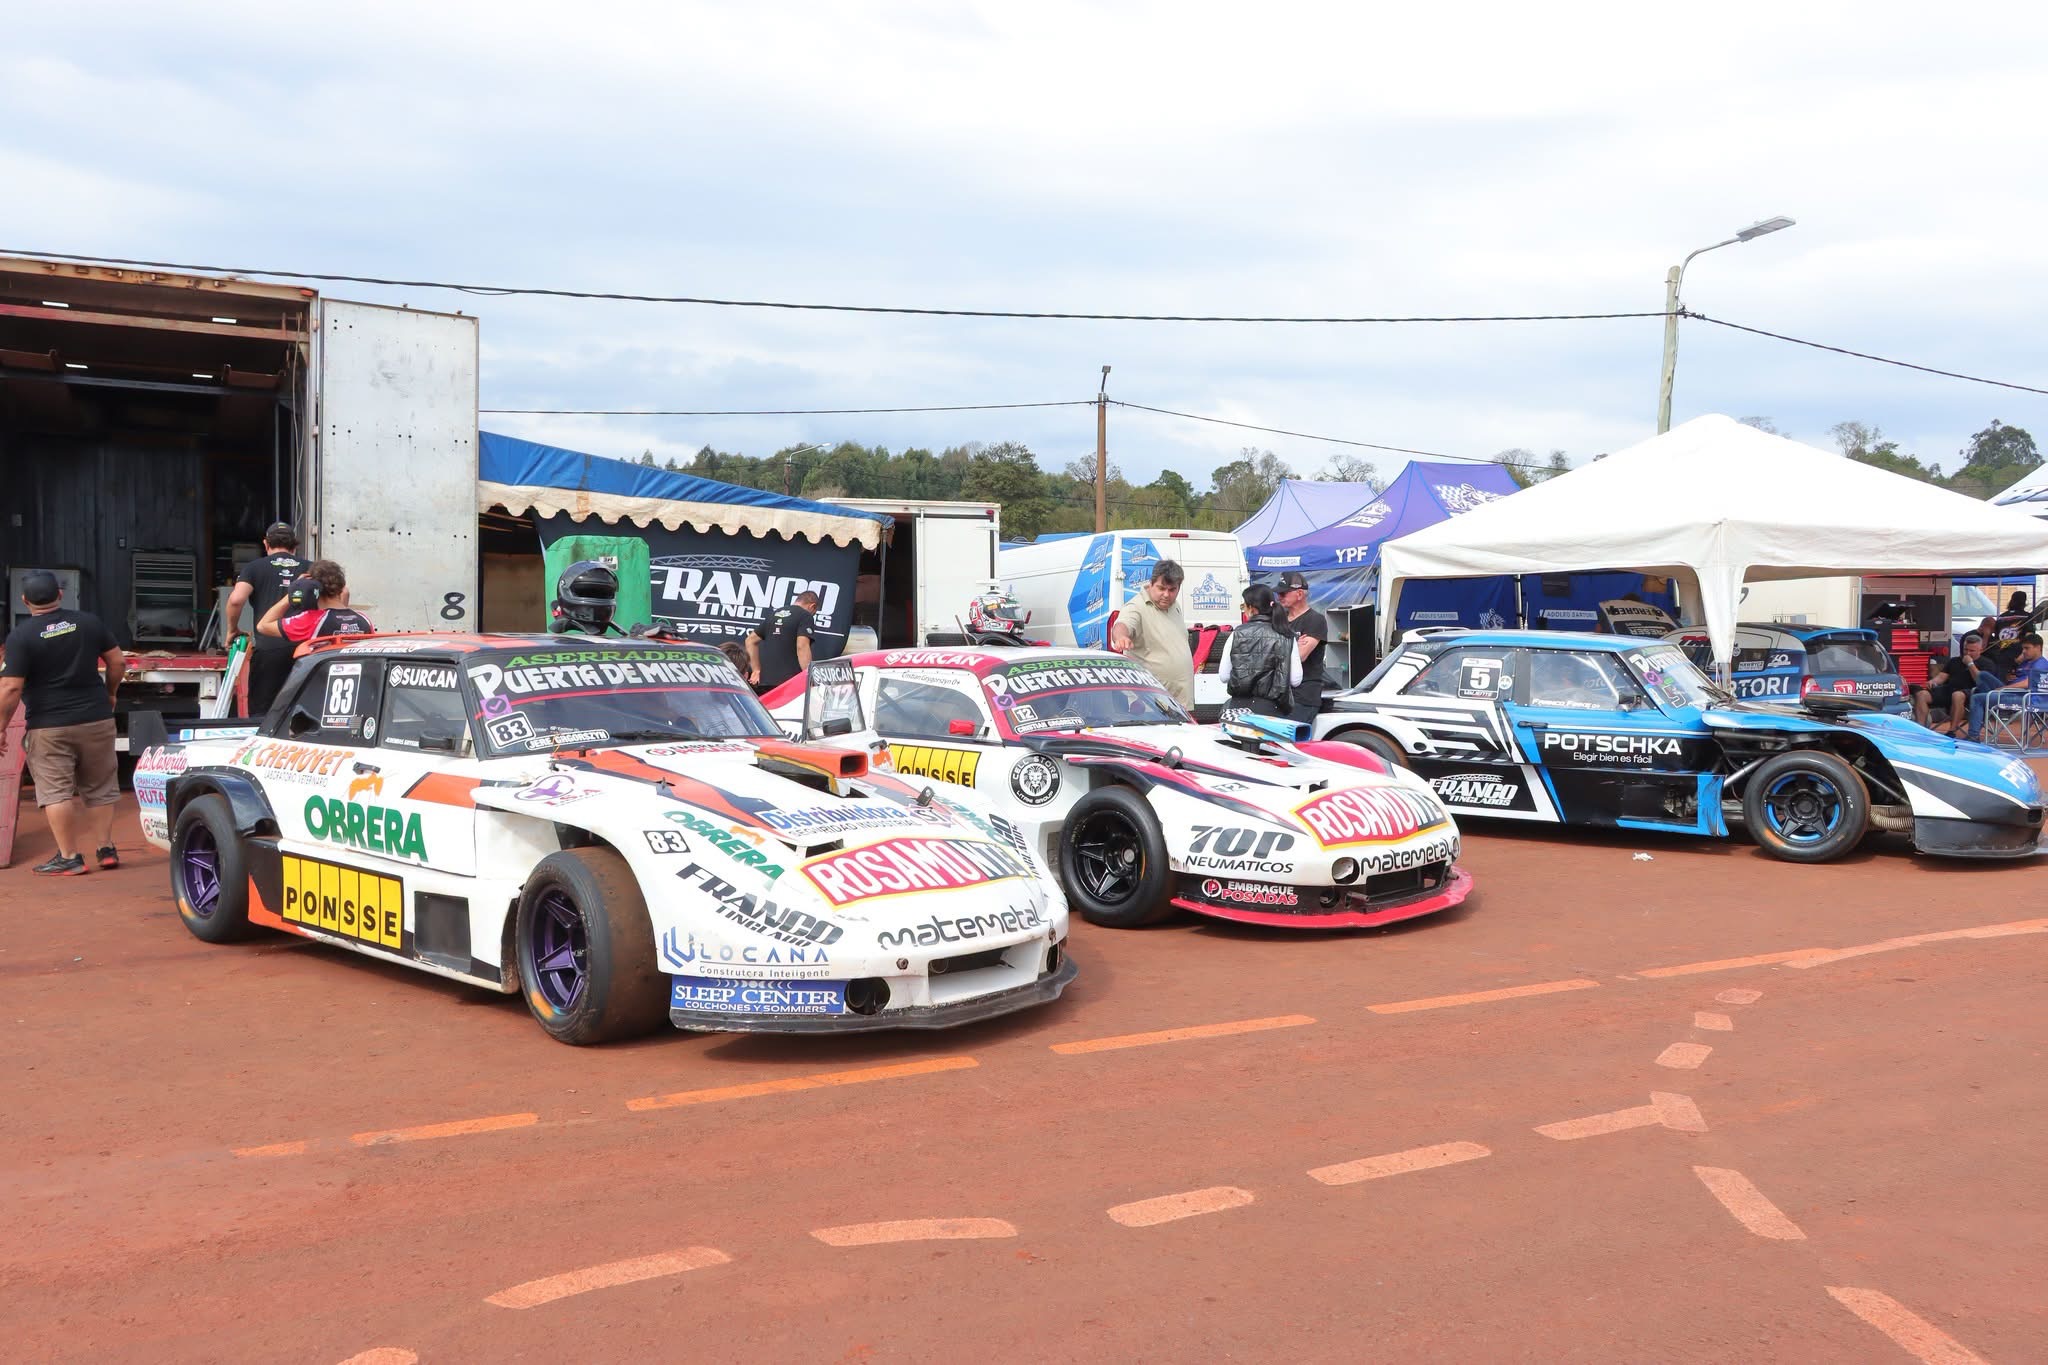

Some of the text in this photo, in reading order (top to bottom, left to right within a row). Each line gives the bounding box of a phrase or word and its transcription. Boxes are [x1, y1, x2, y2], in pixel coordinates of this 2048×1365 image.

[1336, 546, 1369, 563] YPF
[440, 591, 466, 620] 8
[696, 601, 832, 629] TINGLS
[677, 622, 723, 633] 3755
[504, 650, 722, 668] ASERRADERO
[900, 651, 985, 666] SURCAN
[1007, 659, 1145, 677] ASERRADERO
[401, 668, 458, 689] SURCAN
[467, 662, 604, 699] PUERTA
[600, 663, 644, 685] DE
[820, 667, 854, 681] SURCAN
[981, 667, 1073, 696] PUERTA
[1072, 667, 1098, 686] DE
[1470, 668, 1490, 689] 5
[329, 678, 355, 714] 83
[1731, 676, 1790, 698] RTORI
[1856, 682, 1897, 690] Nordeste
[1016, 708, 1035, 720] 12
[495, 720, 528, 742] 83
[528, 737, 553, 749] JERE
[1544, 732, 1682, 755] POTSCHKA
[149, 747, 188, 771] Caserita
[254, 743, 356, 776] CHEMOVET
[1012, 756, 1059, 780] CELL STORE
[1573, 752, 1653, 764] Elegir bien es fácil
[264, 770, 329, 788] LABORATORIO VETERINARIO
[899, 765, 972, 787] ONSSE
[138, 789, 167, 805] RUTA
[1429, 778, 1518, 799] FRANCO
[1449, 795, 1512, 806] TINGLADOS
[761, 804, 907, 830] Distribuidora
[1306, 786, 1441, 841] ROSAMONTE
[304, 794, 428, 862] OBRERA
[788, 818, 922, 838] SEGURIDAD INDUSTRIAL
[646, 832, 688, 853] 83
[663, 809, 786, 889] OBRERA
[1189, 824, 1296, 859] TOP
[806, 838, 1031, 904] ROSAMONTE
[1185, 856, 1295, 873] NEUMATICOS
[1221, 888, 1299, 905] POSADAS
[1227, 881, 1295, 895] EMBRAGUE
[286, 886, 398, 938] PONSSE
[675, 862, 844, 945] FRANCO
[878, 900, 1047, 948] matemetal
[675, 985, 841, 1005] SLEEP CENTER
[685, 1000, 827, 1013] COLCHONES Y SOMMIERS
